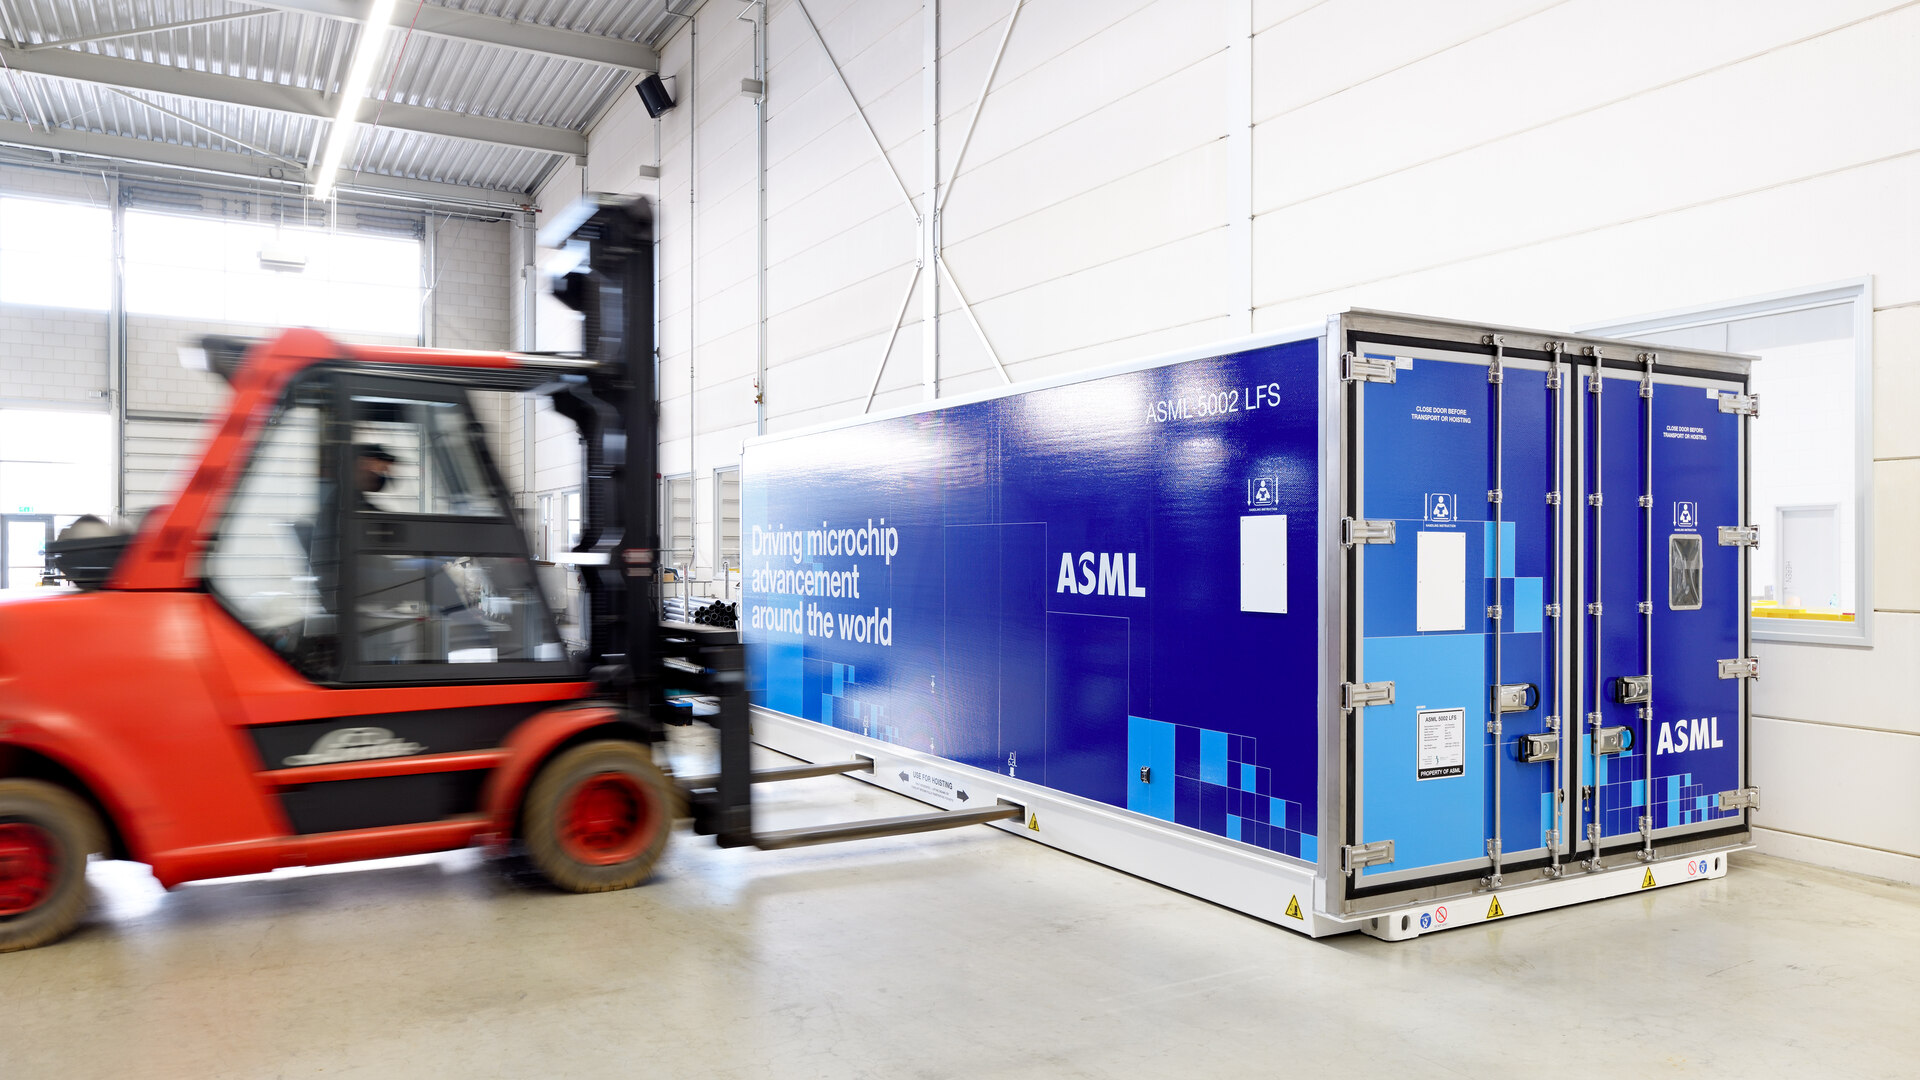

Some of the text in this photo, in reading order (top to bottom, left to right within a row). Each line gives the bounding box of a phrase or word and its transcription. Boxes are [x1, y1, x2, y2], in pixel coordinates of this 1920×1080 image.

[1146, 382, 1281, 424] ASML 5002 LFS
[1411, 413, 1440, 422] TRANSPORT
[1449, 416, 1472, 424] HOISTING
[1416, 405, 1467, 416] CLOSE DOOR BEFORE
[752, 518, 899, 565] Driving microchip
[752, 561, 860, 599] advancement
[1056, 551, 1146, 598] ASML
[752, 601, 892, 646] around the world
[1656, 716, 1724, 756] ASML
[912, 770, 921, 780] USE
[922, 773, 931, 782] FOR
[932, 776, 953, 790] HOISTING
